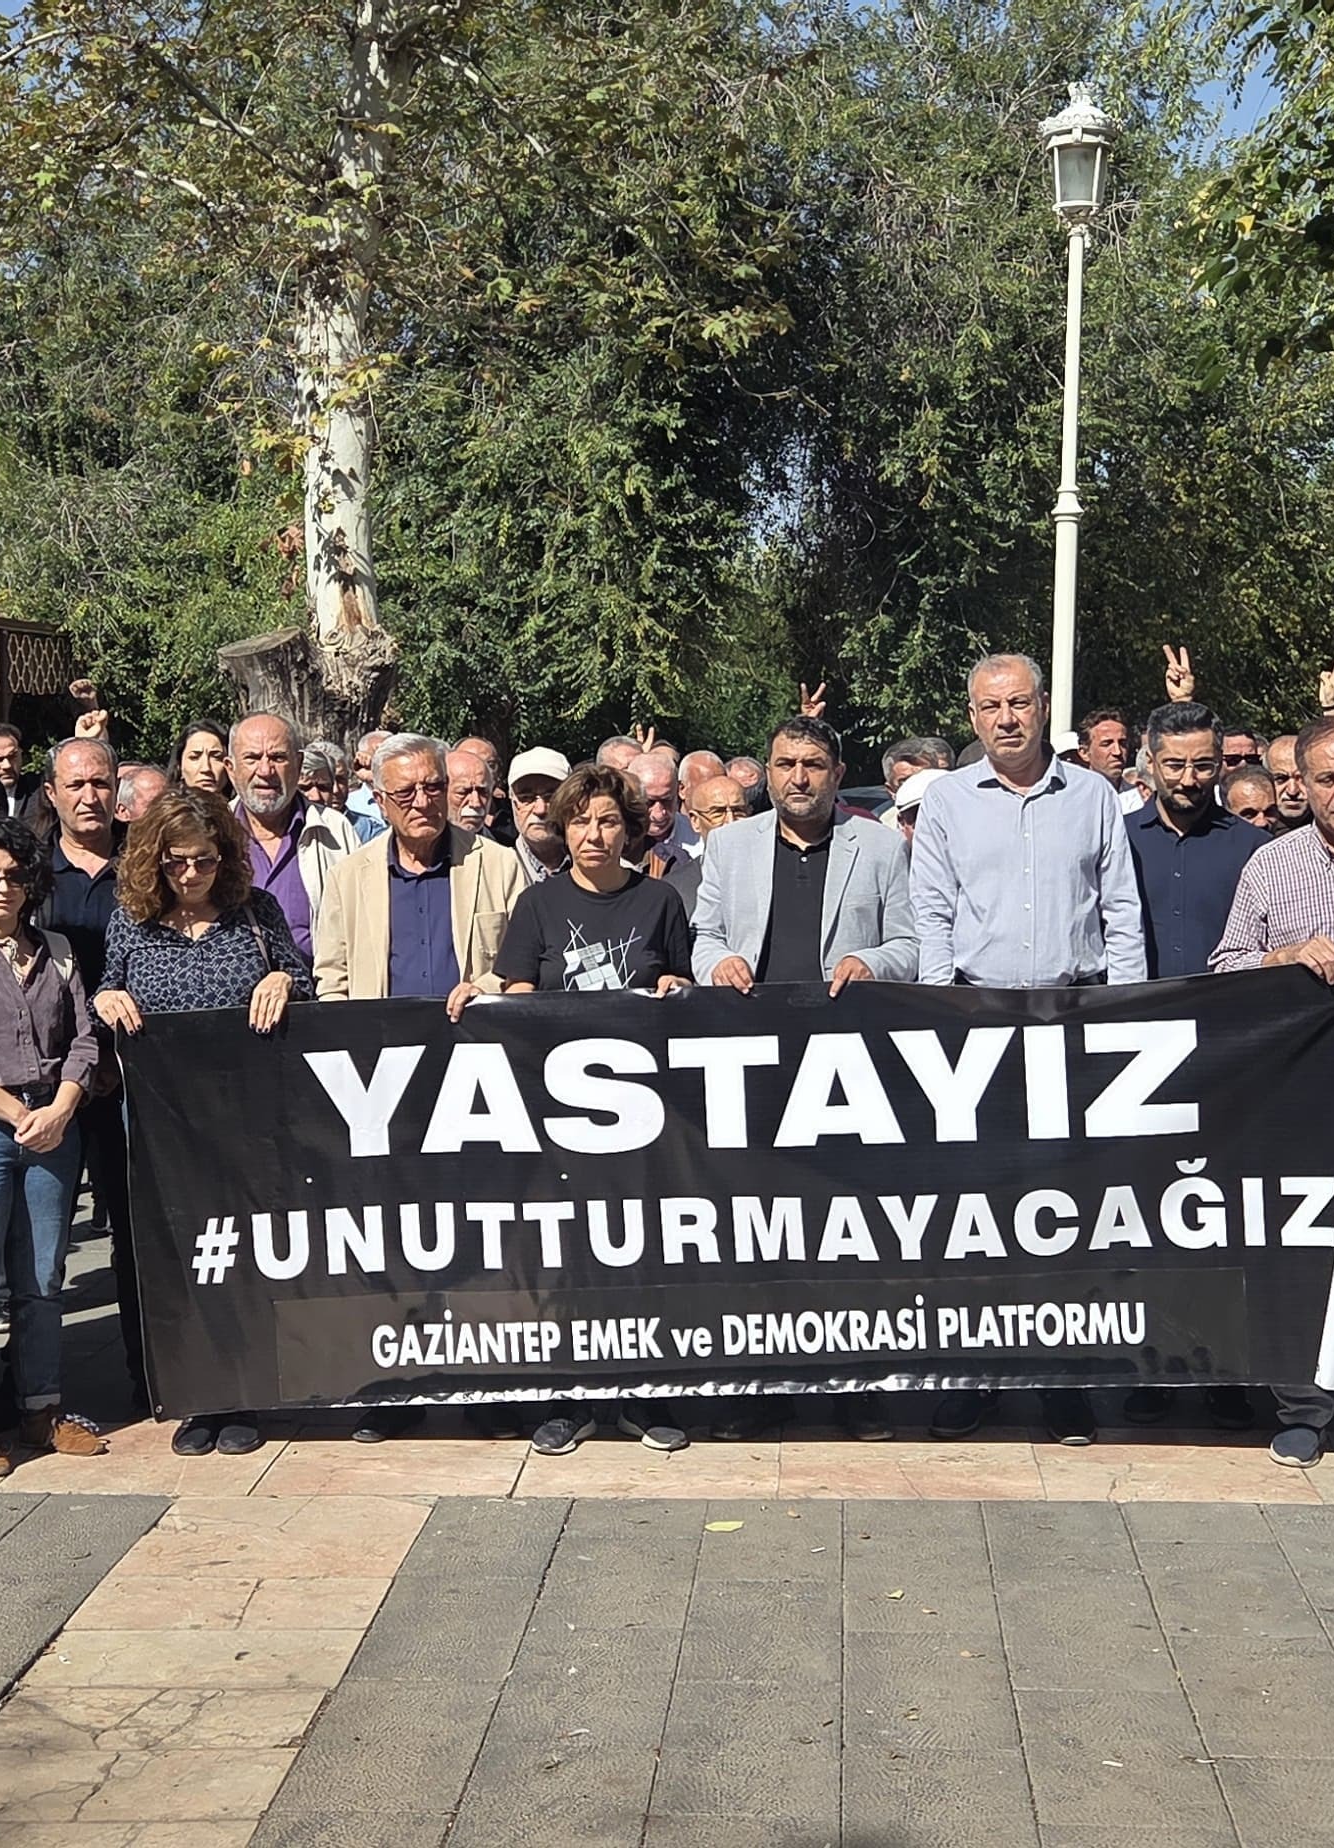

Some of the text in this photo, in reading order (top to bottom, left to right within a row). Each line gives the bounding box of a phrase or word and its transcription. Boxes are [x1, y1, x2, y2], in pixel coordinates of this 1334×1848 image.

[303, 1020, 1199, 1157] YASTAYIZ
[371, 1294, 1147, 1369] GAZİANTEP EMEK ve DEMOKRASİ PLATFORMU
